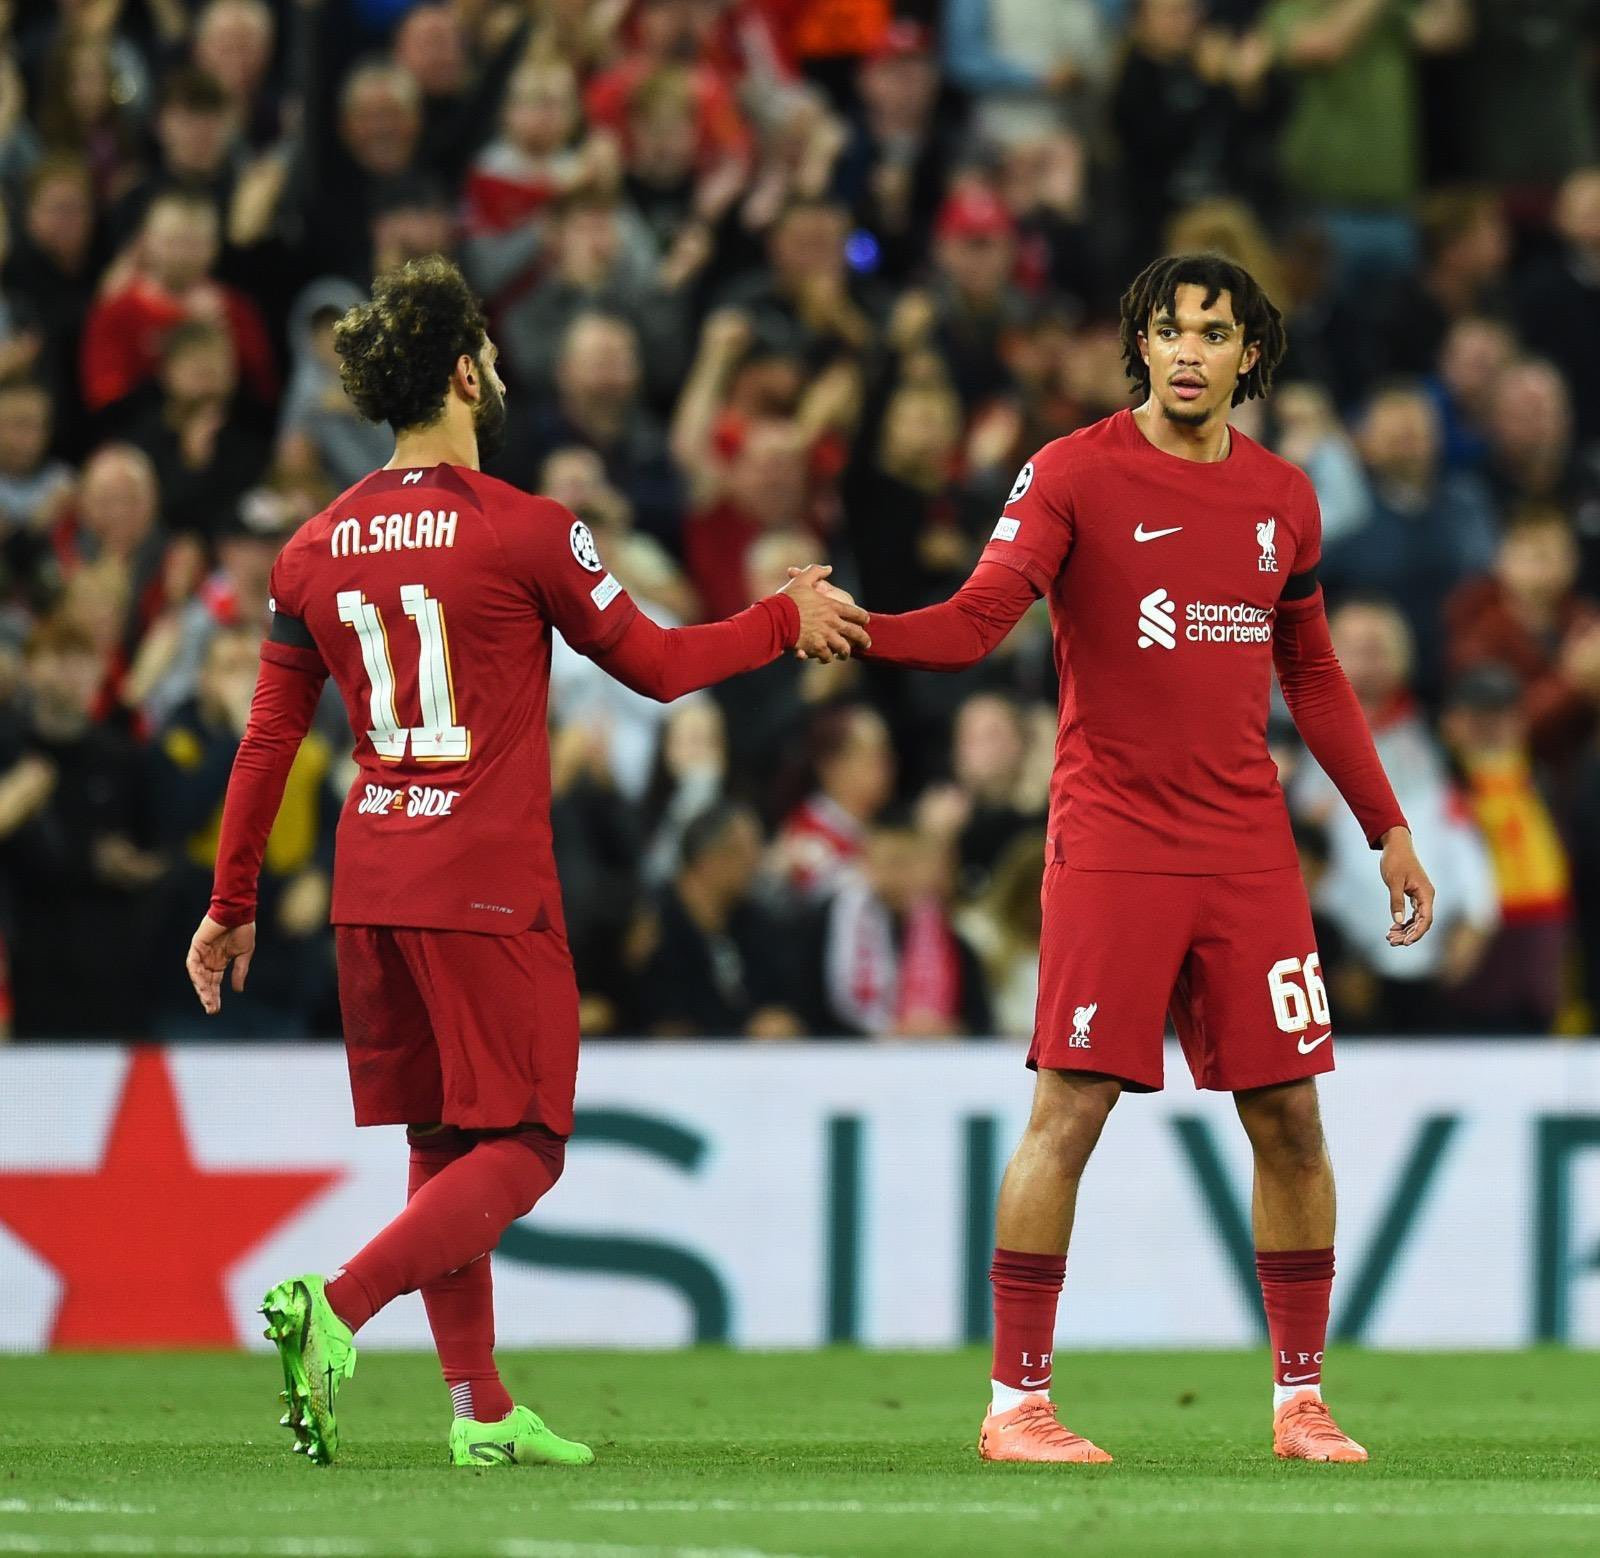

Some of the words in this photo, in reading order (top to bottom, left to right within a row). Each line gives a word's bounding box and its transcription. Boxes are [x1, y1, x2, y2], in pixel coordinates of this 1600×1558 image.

[331, 510, 458, 558] M.SALAH
[1185, 622, 1271, 643] chartered
[336, 584, 471, 762] 11
[407, 784, 461, 817] SIDE
[1267, 952, 1331, 1034] 66
